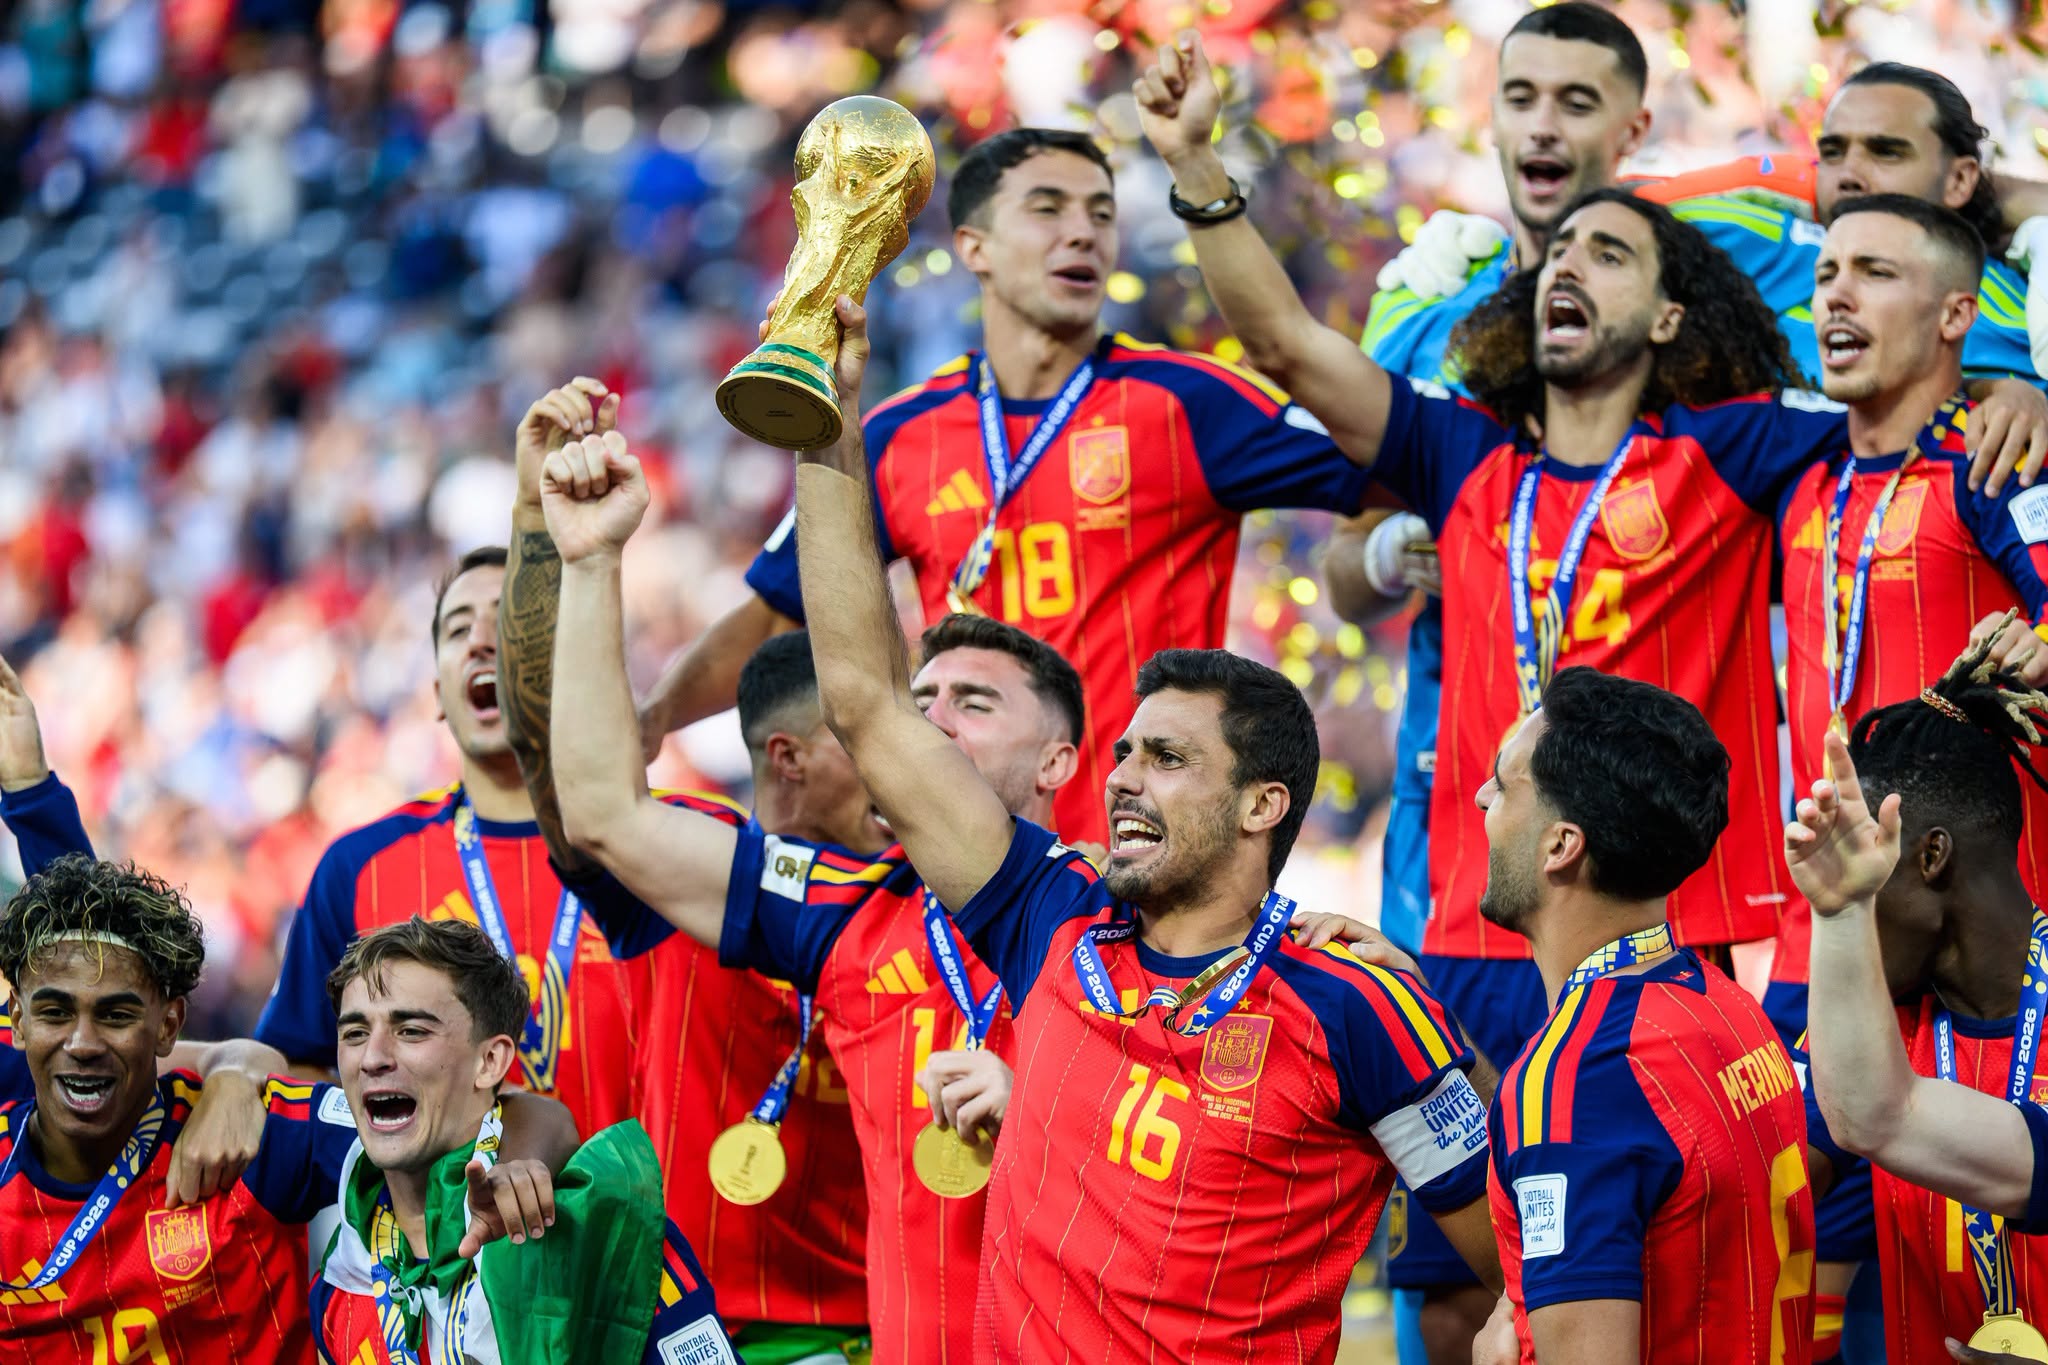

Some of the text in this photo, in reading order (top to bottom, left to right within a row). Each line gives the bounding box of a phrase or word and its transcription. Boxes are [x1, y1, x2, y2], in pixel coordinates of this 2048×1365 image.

[1021, 420, 1055, 465] WORLD
[1048, 397, 1070, 426] CUP
[1591, 476, 1613, 504] CUP
[1565, 501, 1600, 554] WORLD
[993, 521, 1076, 623] 18
[1559, 549, 1578, 583] FIFA
[1851, 570, 1864, 624] 2026
[1846, 622, 1859, 654] CUP
[556, 914, 575, 947] FIFA
[930, 917, 952, 959] 2026
[1252, 924, 1275, 954] CUP
[941, 955, 958, 978] CUP
[1076, 947, 1116, 1014] CUP 2026
[1218, 952, 1257, 1002] 2026
[1939, 1020, 1952, 1074] 2026
[2018, 1007, 2037, 1064] 2026
[1419, 1074, 1469, 1119] FOOTBALL
[1716, 1039, 1794, 1121] MERINO
[2012, 1064, 2027, 1096] CUP
[1106, 1062, 1192, 1183] 16
[1425, 1086, 1479, 1133] UNITES
[1433, 1129, 1462, 1150] the
[1466, 1129, 1487, 1148] FIFA
[32, 1194, 110, 1289] RLD CUP 2026
[1530, 1234, 1543, 1244] FIFA
[1533, 1218, 1557, 1233] World
[81, 1306, 171, 1365] 19
[672, 1330, 713, 1357] FOOTBALL
[677, 1341, 719, 1365] UNITES
